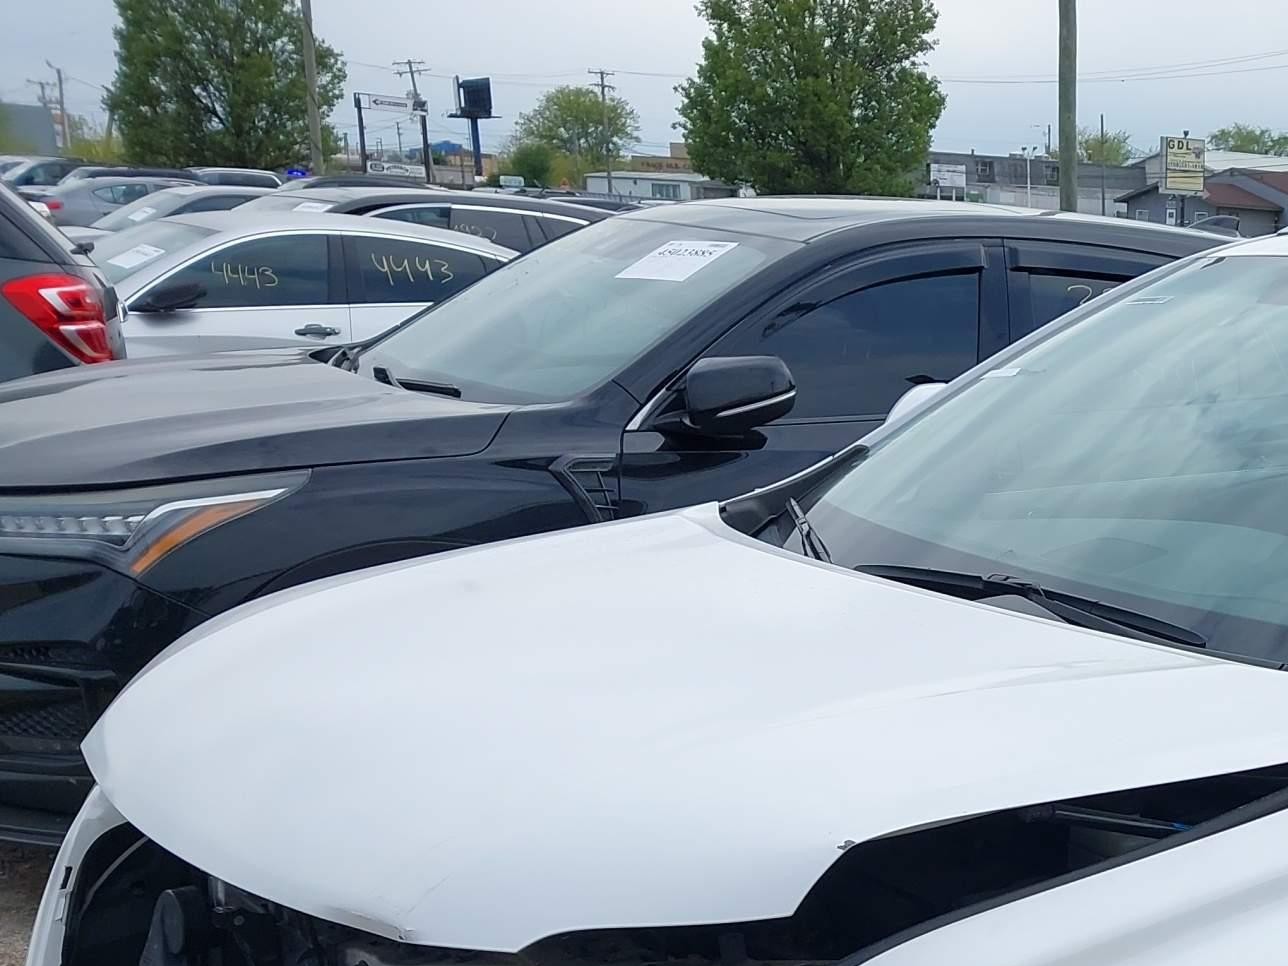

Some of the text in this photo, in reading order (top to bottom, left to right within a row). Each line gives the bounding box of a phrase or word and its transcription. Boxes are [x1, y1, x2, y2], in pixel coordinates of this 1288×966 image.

[1168, 139, 1192, 151] GDL
[211, 261, 279, 289] 4443
[371, 252, 454, 286] 4443
